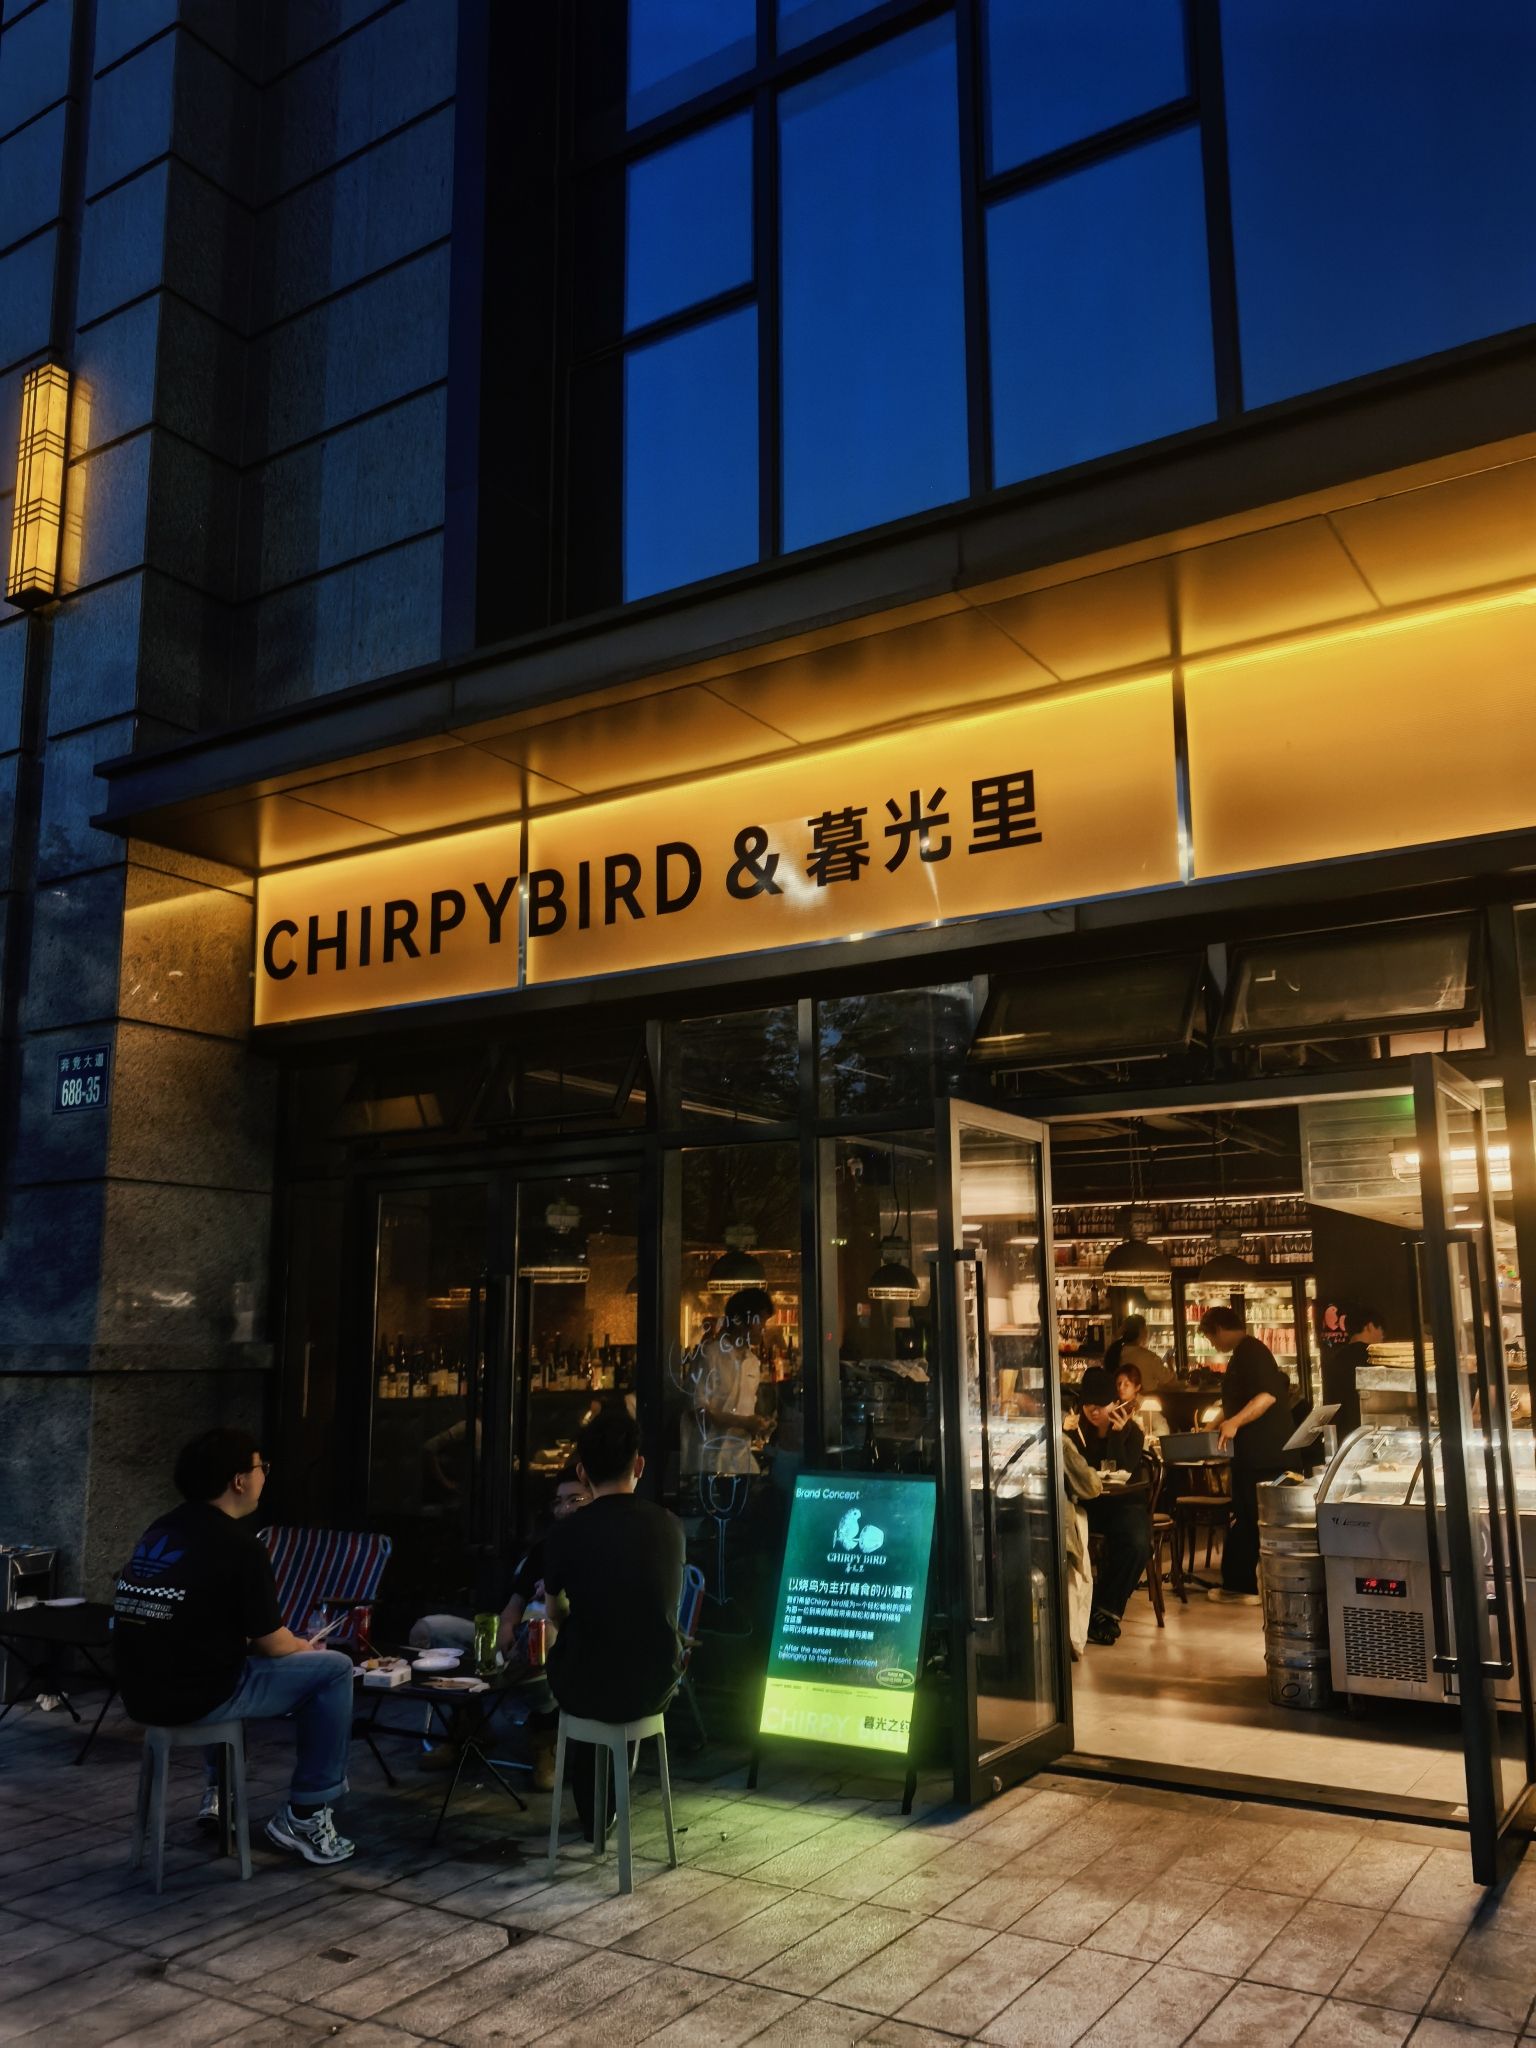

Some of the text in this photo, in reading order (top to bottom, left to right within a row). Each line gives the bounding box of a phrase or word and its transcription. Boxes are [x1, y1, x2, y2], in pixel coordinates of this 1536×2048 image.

[725, 825, 784, 900] &
[806, 769, 1043, 887] 暮光里
[62, 1075, 101, 1107] 688-35
[795, 1487, 861, 1501] Brand Concept
[827, 1553, 888, 1566] CHIRPY BIRD
